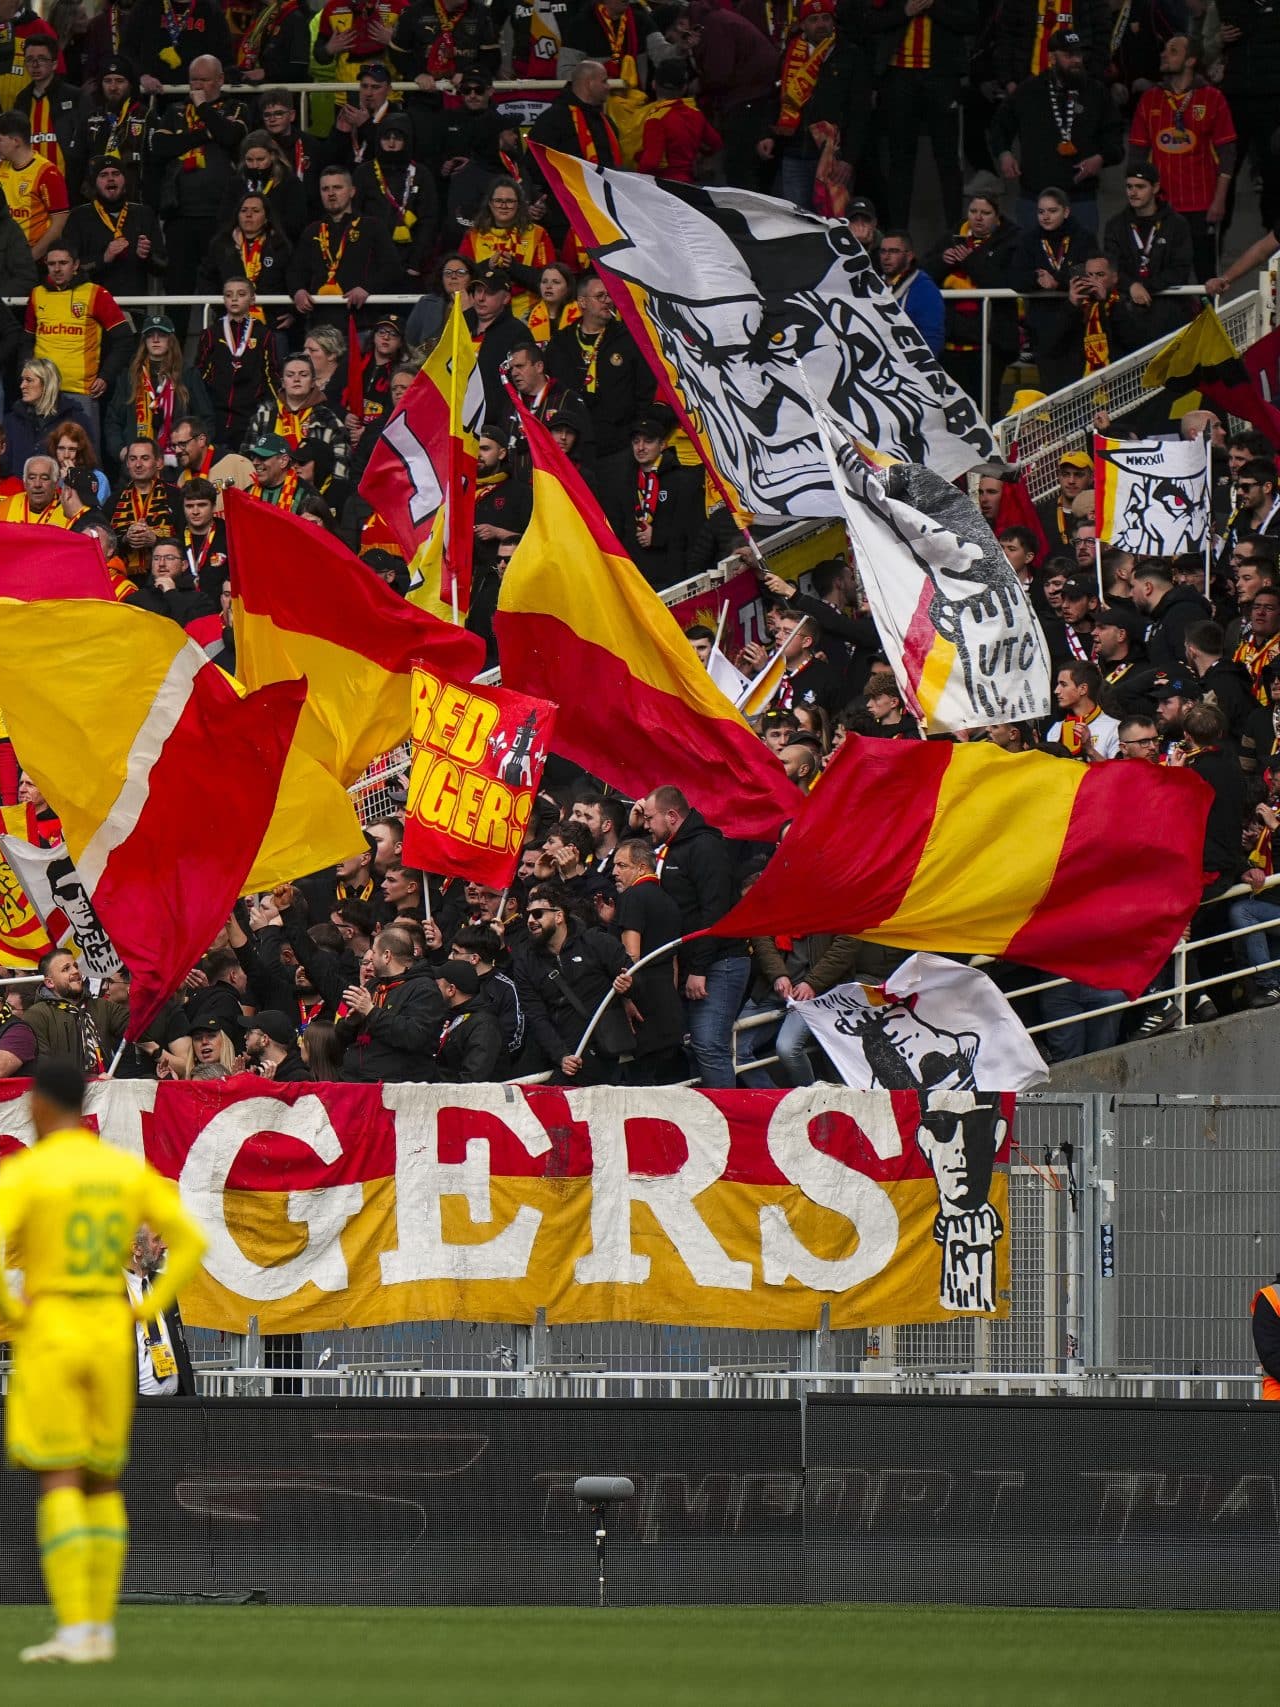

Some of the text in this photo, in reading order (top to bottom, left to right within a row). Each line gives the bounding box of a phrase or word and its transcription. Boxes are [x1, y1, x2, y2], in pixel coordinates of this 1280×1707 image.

[515, 3, 567, 18] Auan
[38, 323, 83, 336] Auchan
[1125, 453, 1166, 467] MMXXII
[979, 632, 1034, 676] UTC
[410, 666, 500, 769] RED
[405, 745, 532, 856] IGERS
[86, 939, 112, 959] RT
[949, 1239, 993, 1276] RT
